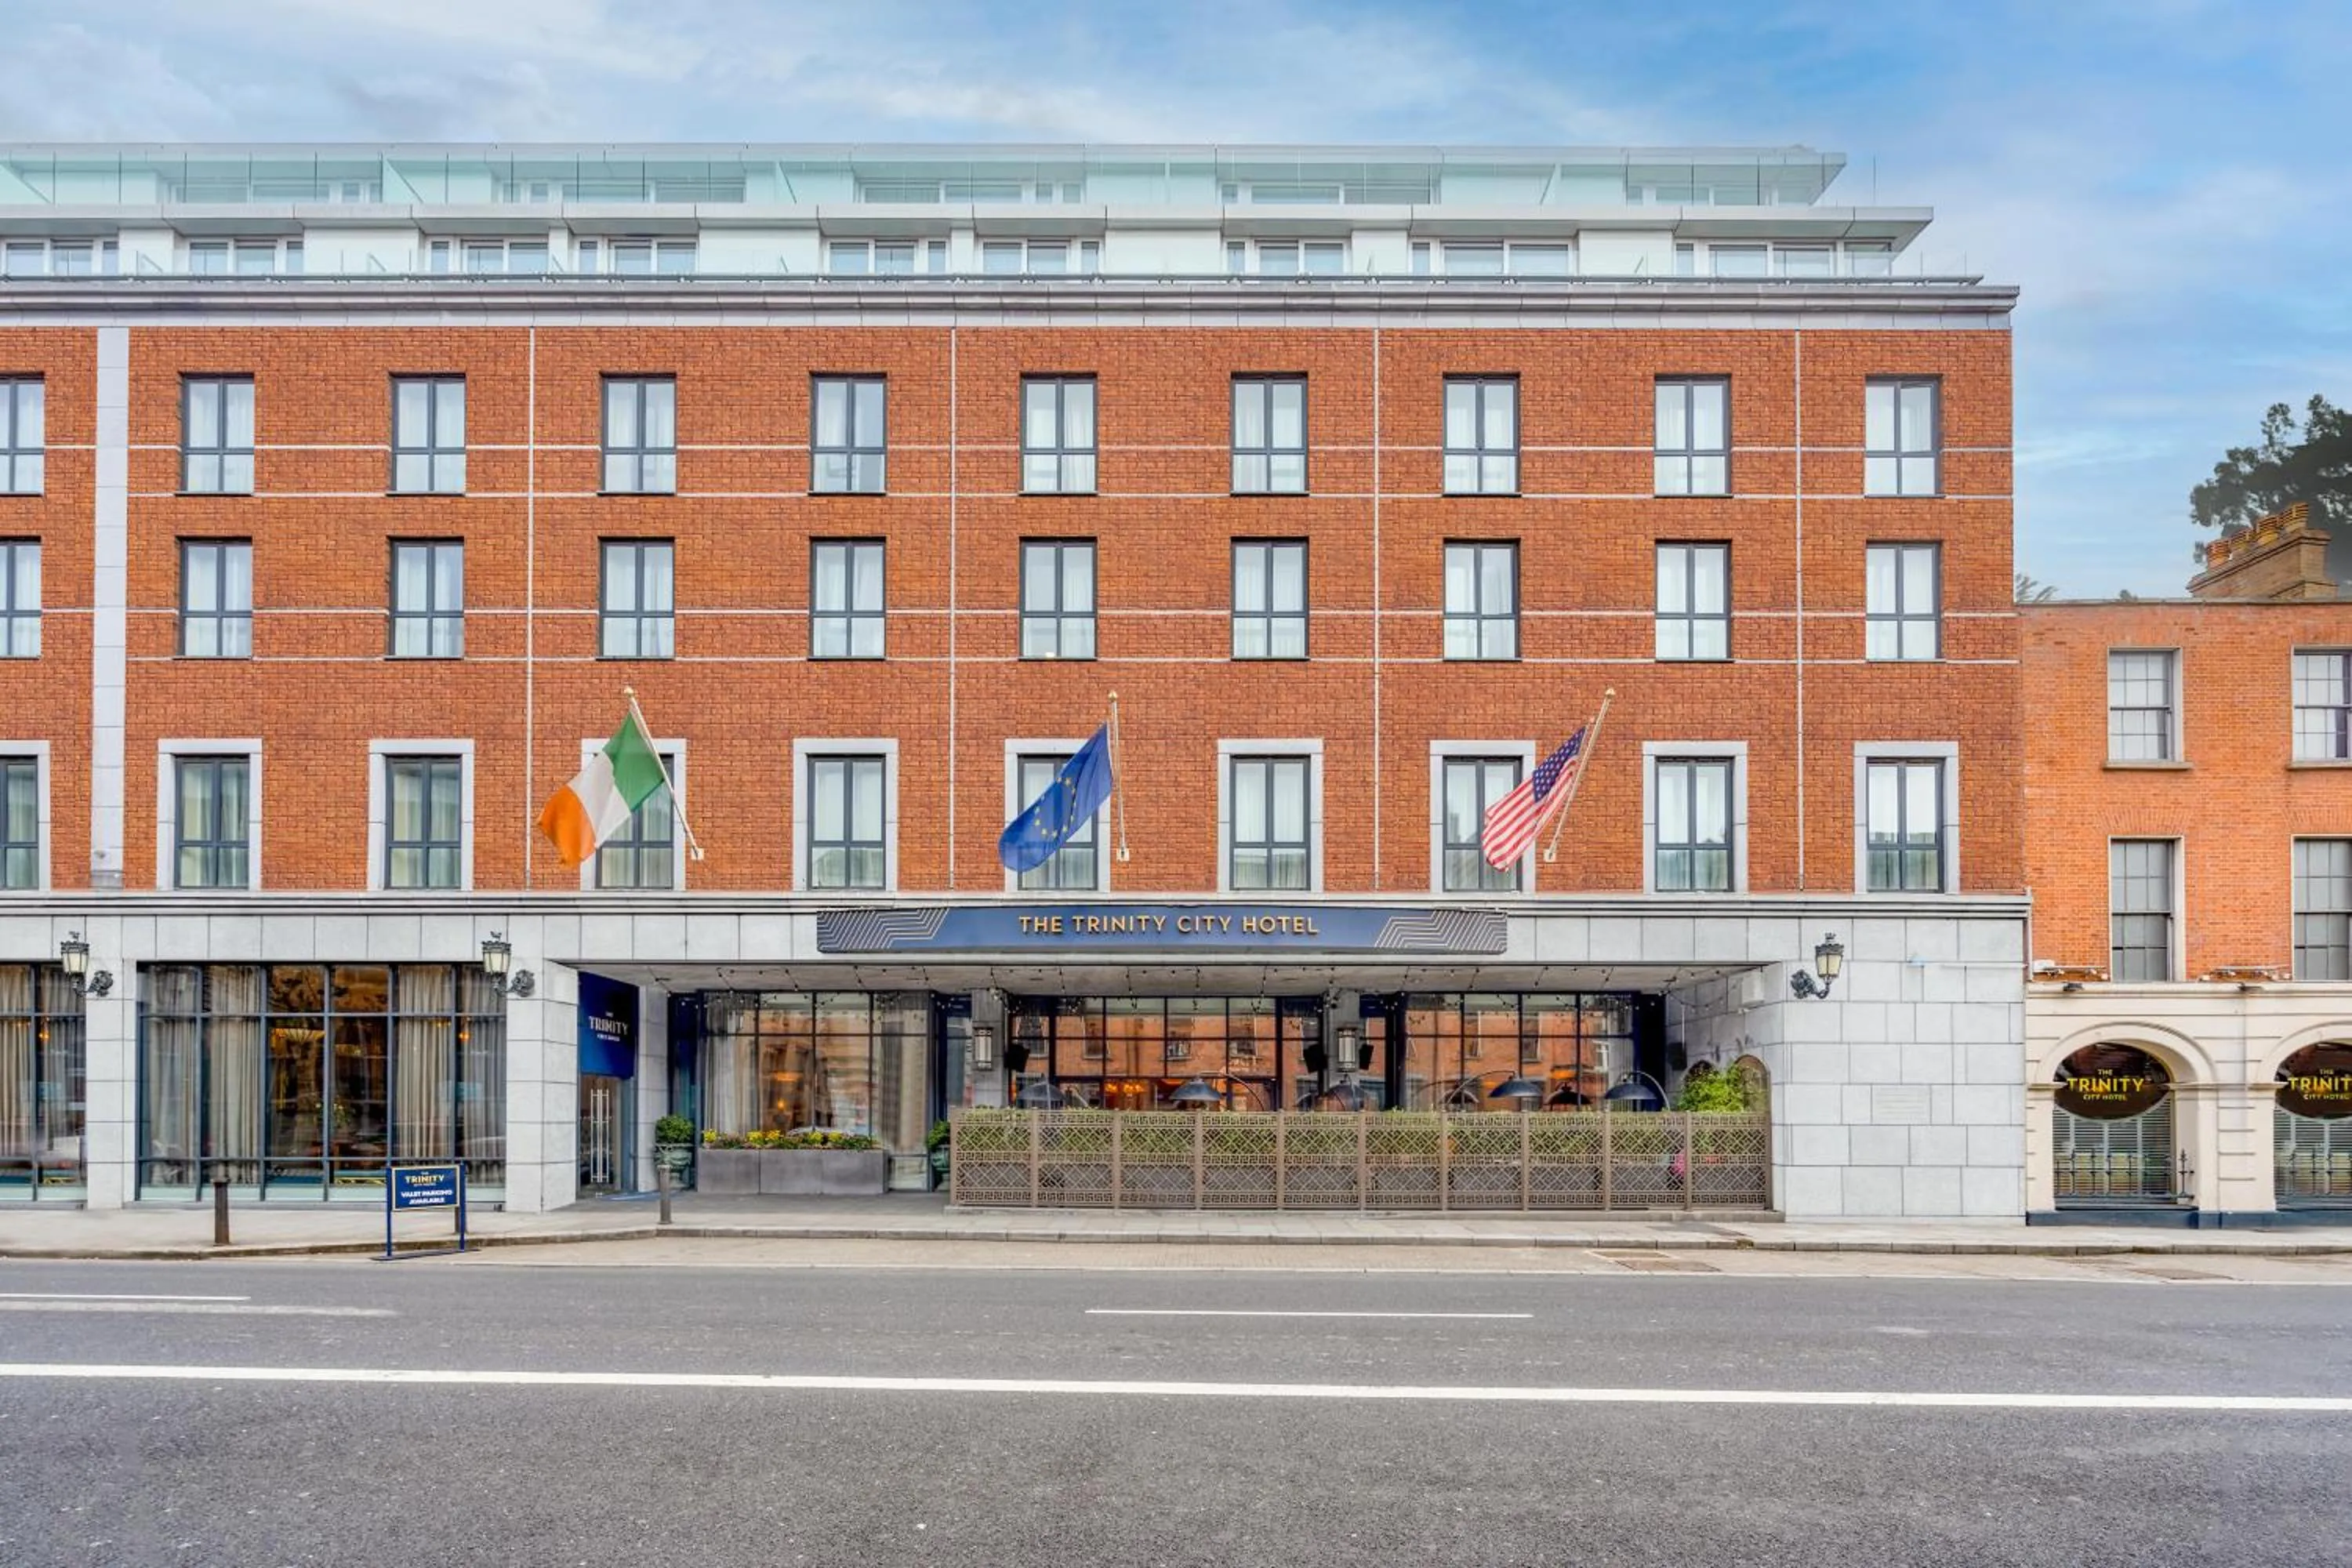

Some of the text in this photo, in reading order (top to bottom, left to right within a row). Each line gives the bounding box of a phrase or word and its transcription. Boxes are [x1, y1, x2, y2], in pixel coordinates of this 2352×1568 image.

[1019, 916, 1319, 933] THE TRINITY CITY HOTEL
[589, 1016, 628, 1036] TRINITY
[2067, 1078, 2144, 1092] TRINITY
[405, 1174, 445, 1185] TRINITY
